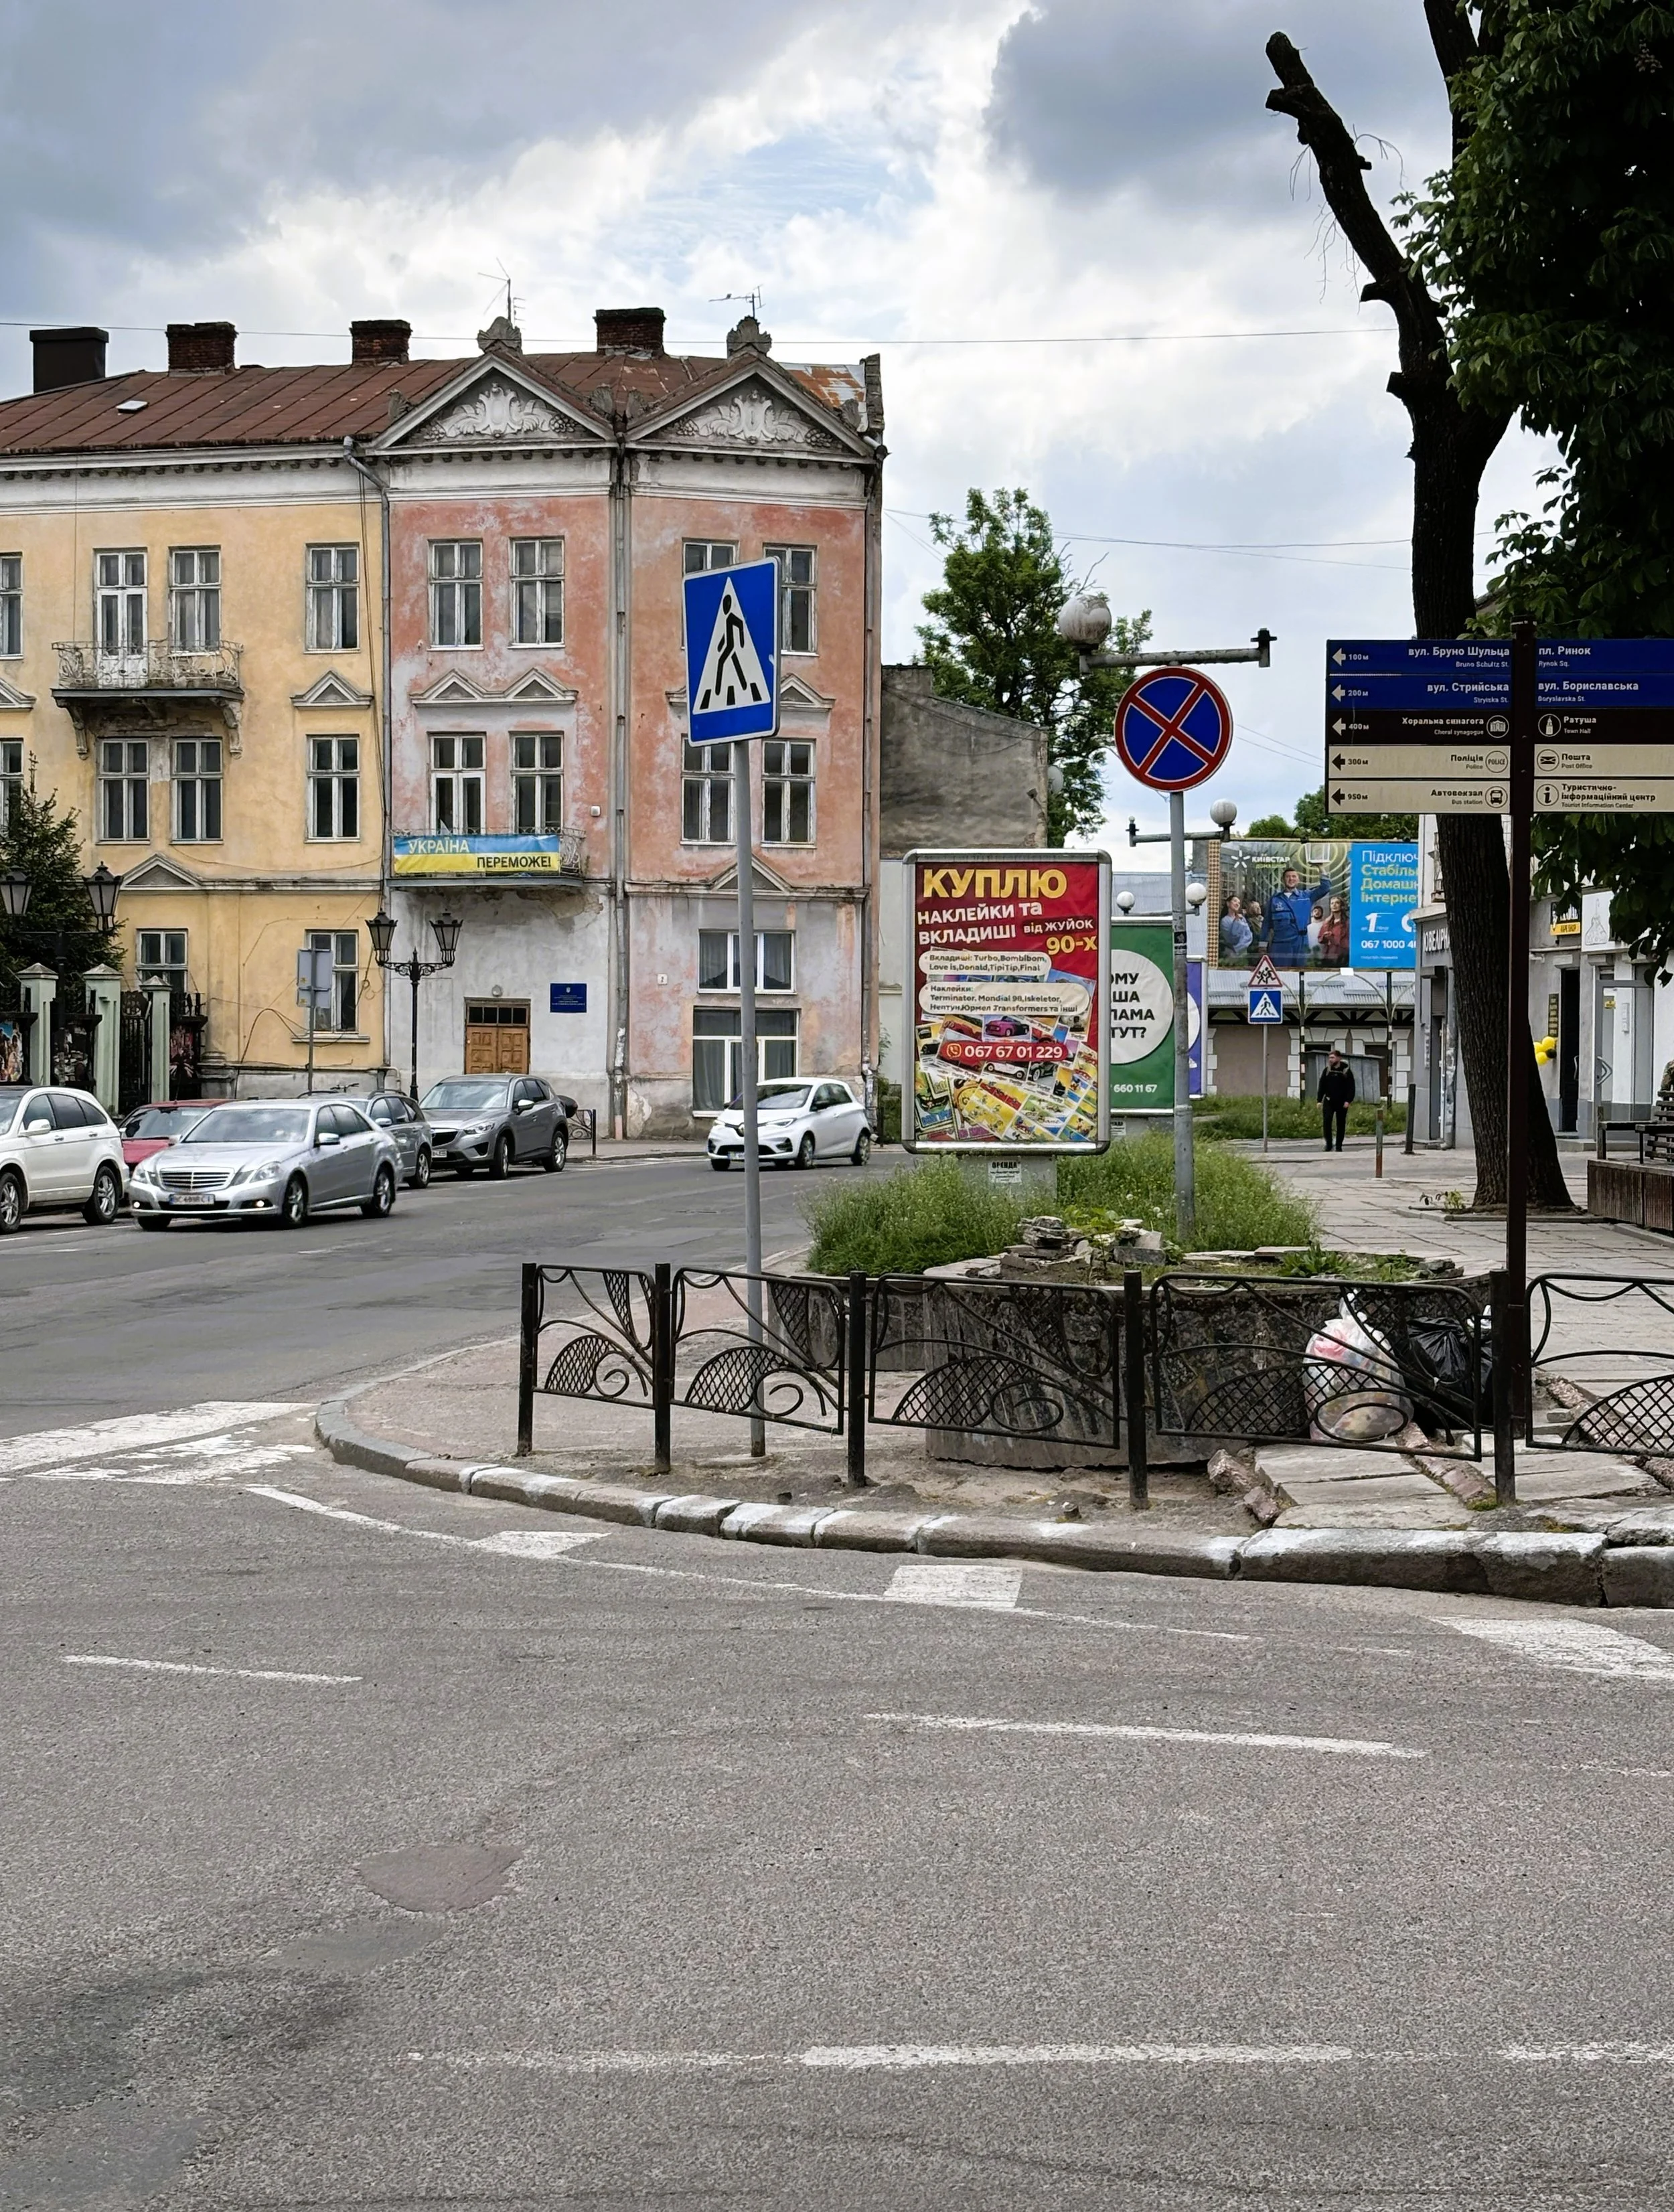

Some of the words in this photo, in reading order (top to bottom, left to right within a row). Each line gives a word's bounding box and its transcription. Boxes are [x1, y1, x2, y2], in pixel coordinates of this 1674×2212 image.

[1408, 648, 1430, 657] вул.
[1433, 647, 1464, 657] Бруно
[1467, 647, 1510, 657] Шульца
[1539, 647, 1555, 655] пл.
[1557, 646, 1591, 655] Ринок
[1427, 684, 1448, 694] вул.
[1452, 682, 1509, 694] Стрийська
[1538, 683, 1559, 692] вул.
[1563, 681, 1639, 692] Бориславська
[1402, 717, 1444, 726] Хоральна
[1564, 716, 1597, 724] Ратуша
[1450, 755, 1483, 763] Поліція
[1562, 793, 1627, 801] інформаційний
[408, 837, 470, 854] УКРАЇНА
[477, 856, 552, 868] ПЕРЕМОЖЕ!
[1251, 853, 1290, 863] КИЇВСТАР
[1361, 864, 1418, 876] Стабіль
[923, 868, 1067, 898] КУПЛЮ
[1361, 891, 1418, 906] Інтерне
[917, 903, 1014, 925] НАКЛЕЙКИ
[1018, 902, 1042, 917] та
[919, 925, 1016, 945] ВКЛАДИШІ
[1023, 922, 1043, 934] від
[1044, 919, 1094, 932] ЖУЙОК
[1046, 935, 1097, 955] 90-х
[1361, 940, 1379, 949] 067
[1381, 940, 1405, 949] 1000
[929, 955, 972, 963] Вкладиші:
[1112, 991, 1140, 1002] ША
[993, 1004, 1048, 1012] Transformers
[1111, 1026, 1147, 1038] ТУТ?
[964, 1046, 992, 1058] 067
[996, 1046, 1014, 1058] 67
[1016, 1046, 1033, 1058] 01
[1036, 1046, 1063, 1058] 229
[1114, 1084, 1134, 1093] 660
[1134, 1084, 1144, 1093] 11
[1145, 1084, 1158, 1093] 67
